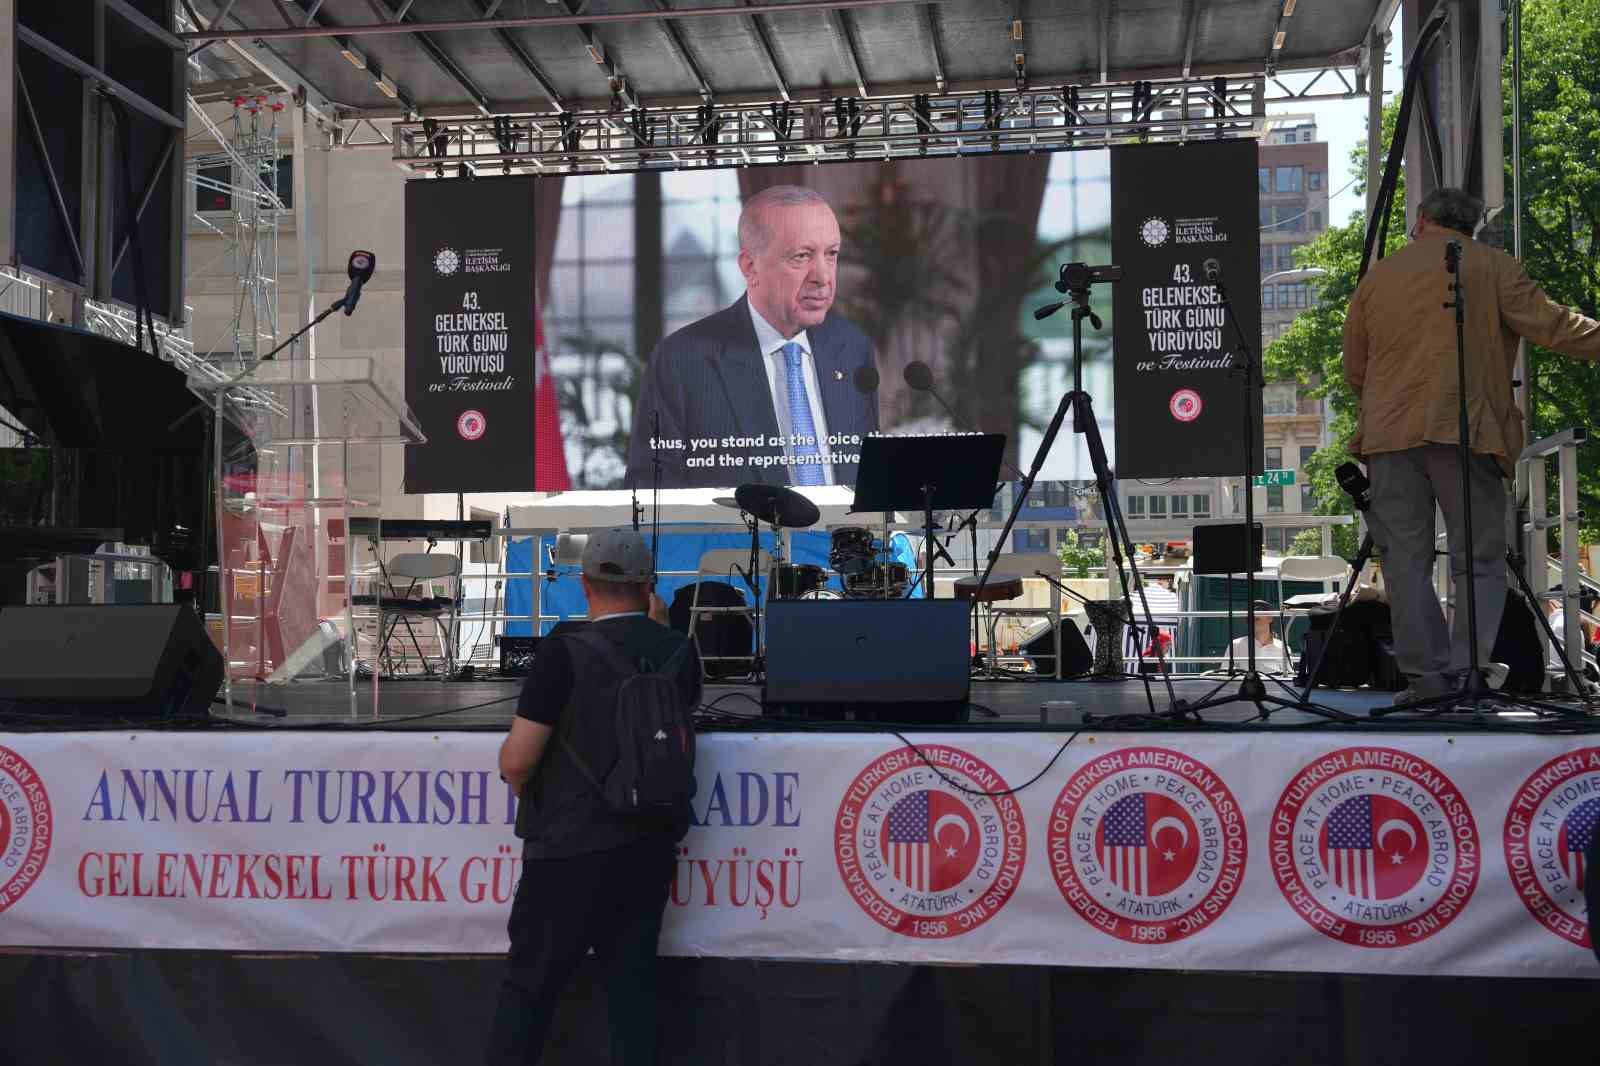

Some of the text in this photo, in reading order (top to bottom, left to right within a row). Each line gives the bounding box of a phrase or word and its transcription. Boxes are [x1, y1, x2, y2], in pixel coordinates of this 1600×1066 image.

[1173, 264, 1194, 284] 43.
[463, 292, 481, 310] 43.
[1144, 306, 1225, 329] TÜRK GÜNÜ
[435, 312, 508, 332] GELENEKSEL
[437, 331, 508, 353] TÜRK GÜNÜ
[1136, 353, 1233, 372] ve Festivali
[429, 376, 514, 392] ve Festivali
[650, 436, 686, 450] thus,
[691, 436, 717, 451] you
[722, 434, 764, 448] stand
[769, 436, 786, 447] as
[791, 434, 815, 446] the
[686, 451, 861, 469] and the representative
[1267, 472, 1280, 485] 24
[851, 752, 909, 803] TURKISH
[913, 749, 998, 790] AMERICAN
[1062, 754, 1124, 807] TURKISH
[1128, 752, 1216, 792] AMERICAN
[1284, 755, 1347, 808] TURKISH
[1352, 751, 1445, 793] AMERICAN
[82, 768, 273, 823] ANNUAL
[284, 770, 491, 825] TURKISH
[689, 770, 801, 827] ADE
[840, 806, 857, 827] OF
[5, 806, 28, 868] ABROAD
[9, 783, 49, 896] ASSOCIATIONS
[863, 771, 999, 881] PEACE AT HOME PEACE ABROAD
[1053, 810, 1071, 833] OF
[1077, 774, 1218, 886] PEACE AT HOME PEACE ABROAD
[1275, 811, 1290, 835] OF
[1299, 775, 1449, 890] PEACE AT HOME PEACE ABROAD
[1537, 777, 1600, 894] PEACE AT HOME
[1204, 791, 1242, 913] ASSOCIATIONS
[1436, 793, 1475, 918] ASSOCIATIONS
[1508, 755, 1585, 940] FEDERATION OF TURKISH
[77, 843, 804, 920] GELENEKSEL TÜRK GÜ ÜYÜŞÜ
[839, 834, 901, 927] FEDERATION
[1053, 839, 1118, 930] FEDERATION
[1275, 841, 1347, 936] FEDERATION
[912, 920, 948, 935] 1956
[1130, 925, 1168, 940] 1956
[1359, 929, 1397, 944] 1956
